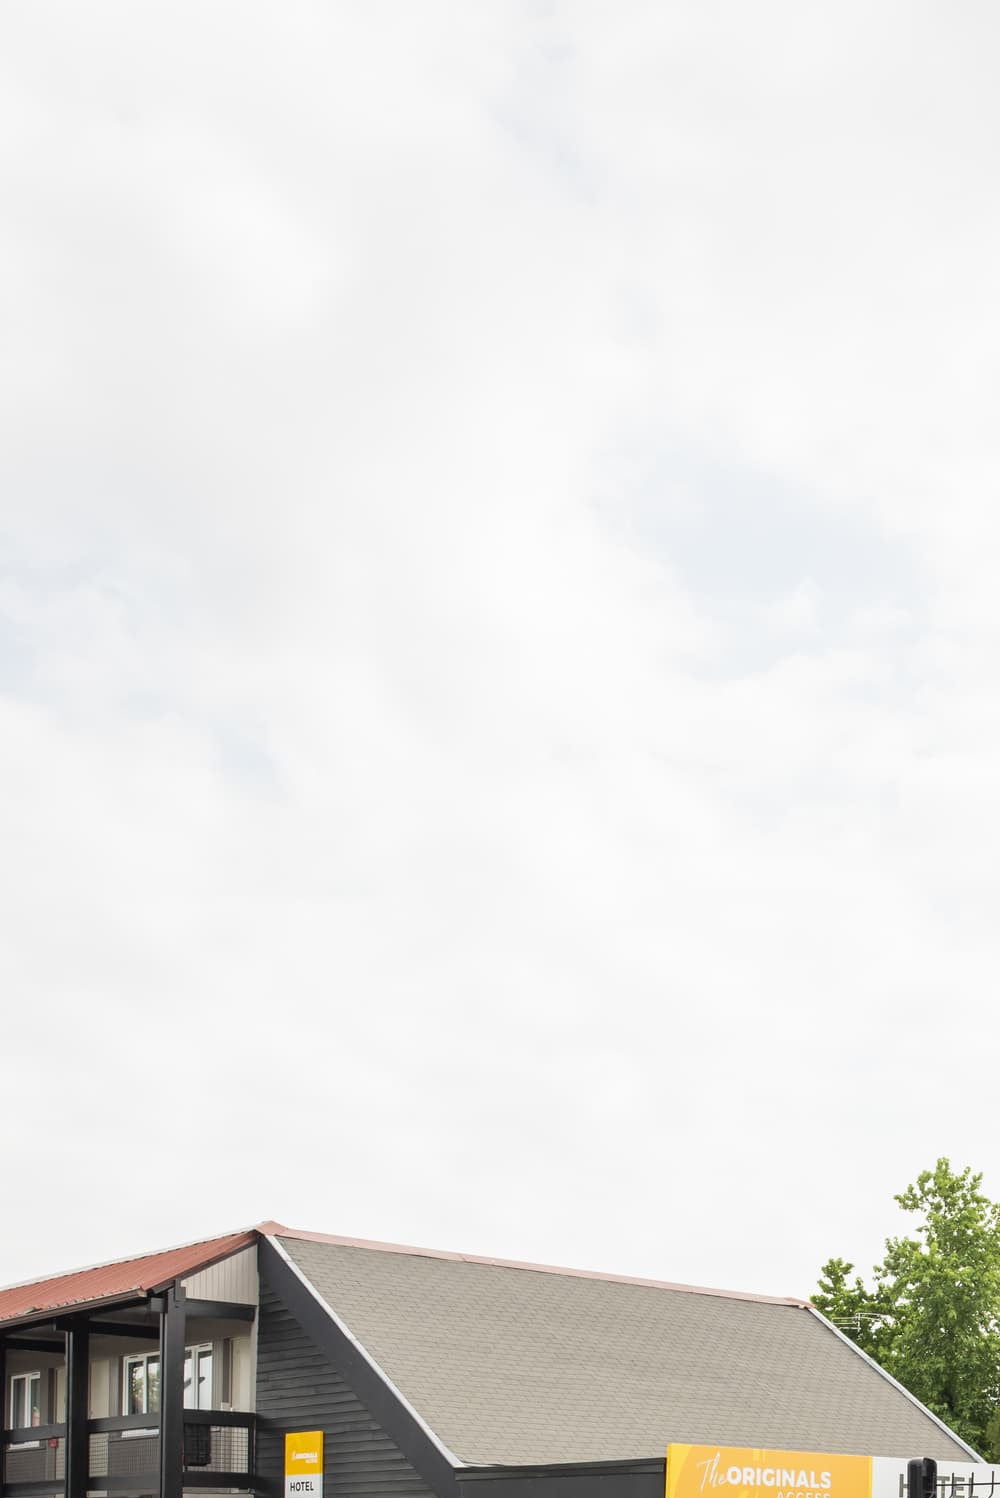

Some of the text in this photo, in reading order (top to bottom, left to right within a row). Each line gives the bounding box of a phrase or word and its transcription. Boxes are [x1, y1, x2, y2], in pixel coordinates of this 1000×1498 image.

[697, 1451, 832, 1491] The ORIGINALS
[290, 1481, 315, 1492] HOTEL
